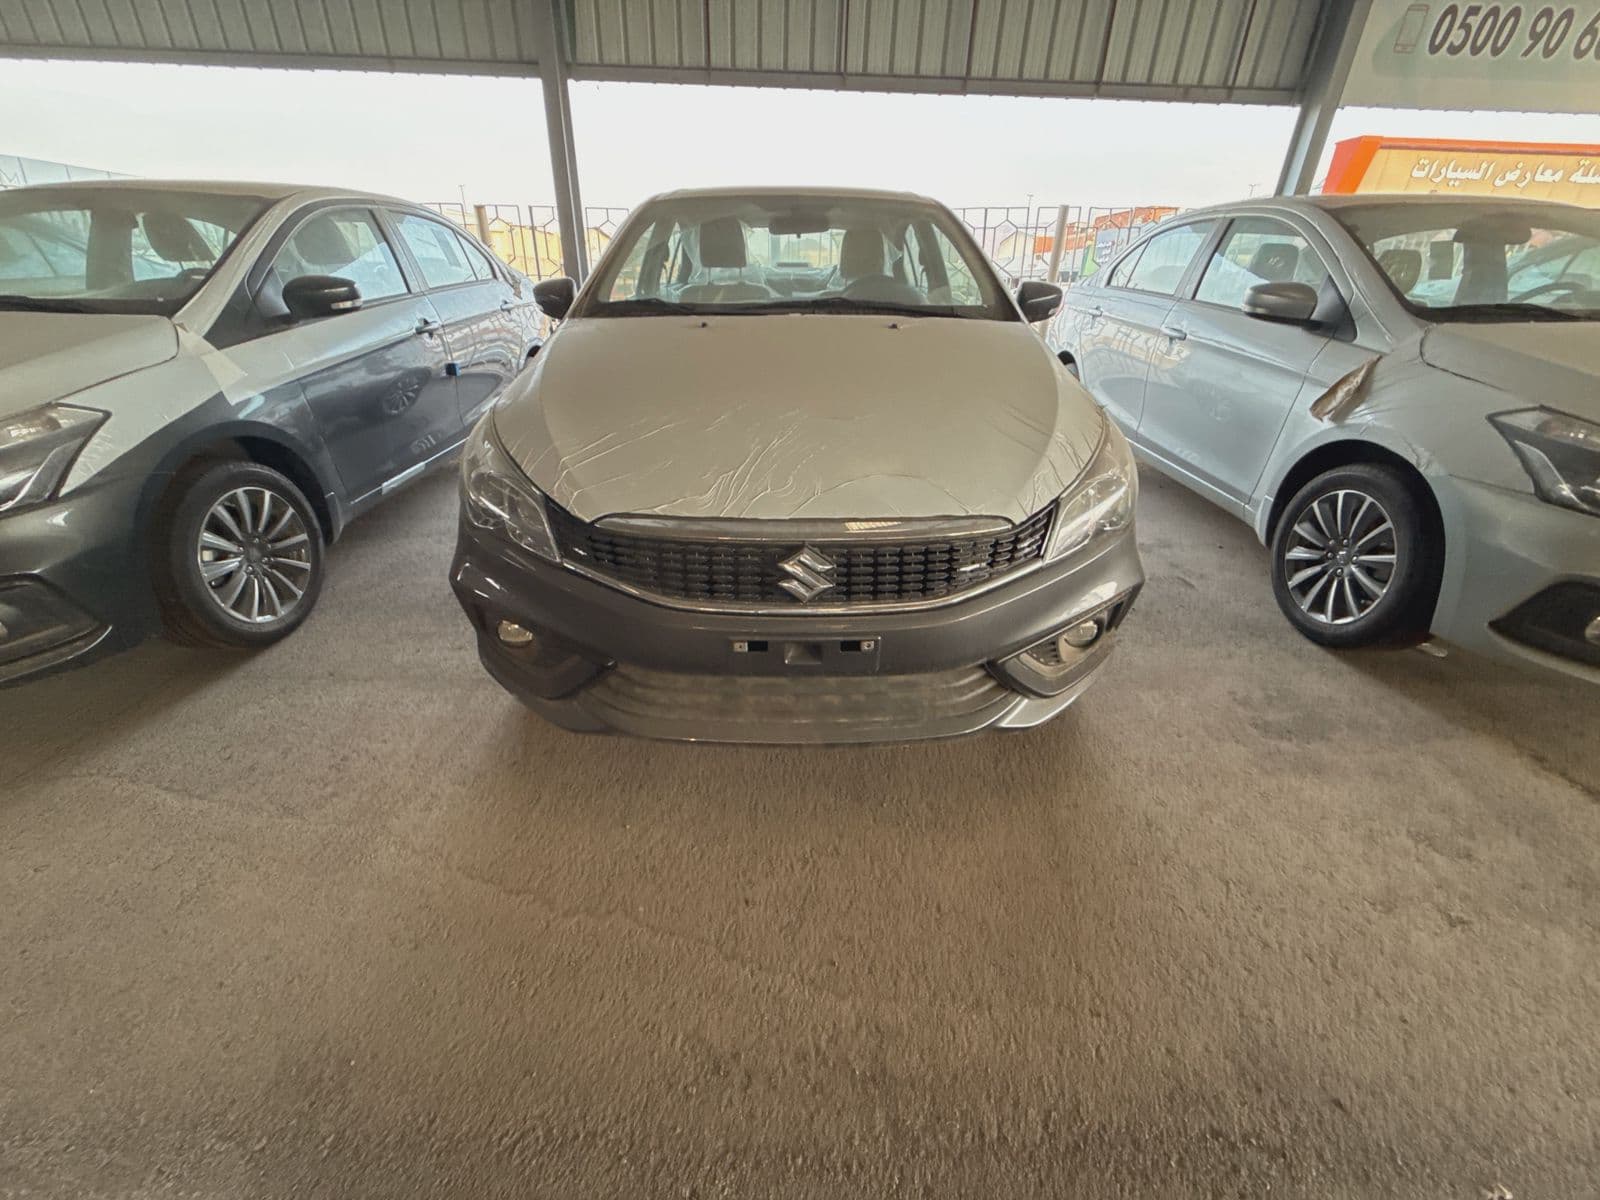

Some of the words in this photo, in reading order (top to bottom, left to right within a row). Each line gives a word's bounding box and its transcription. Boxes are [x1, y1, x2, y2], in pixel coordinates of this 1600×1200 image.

[1428, 5, 1522, 57] 0500
[1521, 7, 1575, 59] 90
[1411, 159, 1496, 187] السيارات
[1494, 161, 1564, 188] معارض
